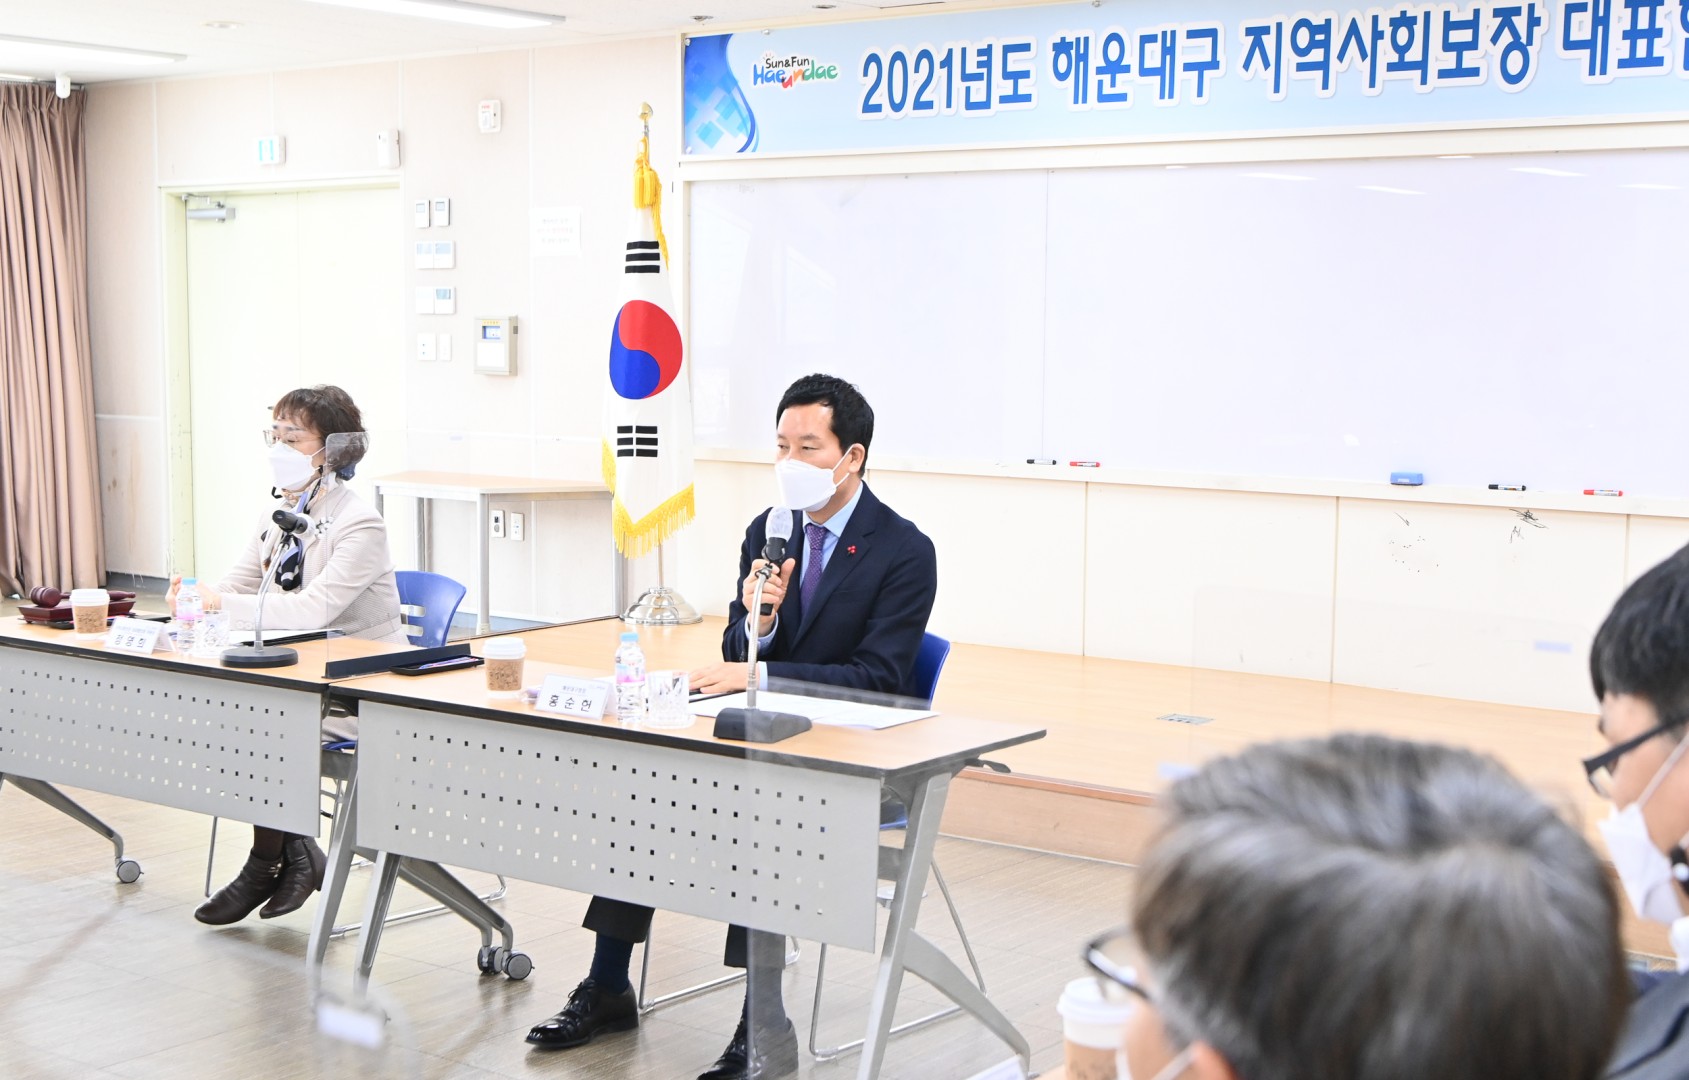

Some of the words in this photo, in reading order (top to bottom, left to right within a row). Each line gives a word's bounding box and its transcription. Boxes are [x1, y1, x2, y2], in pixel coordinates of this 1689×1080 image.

[765, 56, 810, 69] Sun&Fun
[861, 42, 1032, 114] 2021년도
[1052, 28, 1220, 105] 해운대구
[1243, 3, 1542, 94] 지역사회보장
[1564, 0, 1689, 76] 대표
[753, 59, 838, 88] Haeundae
